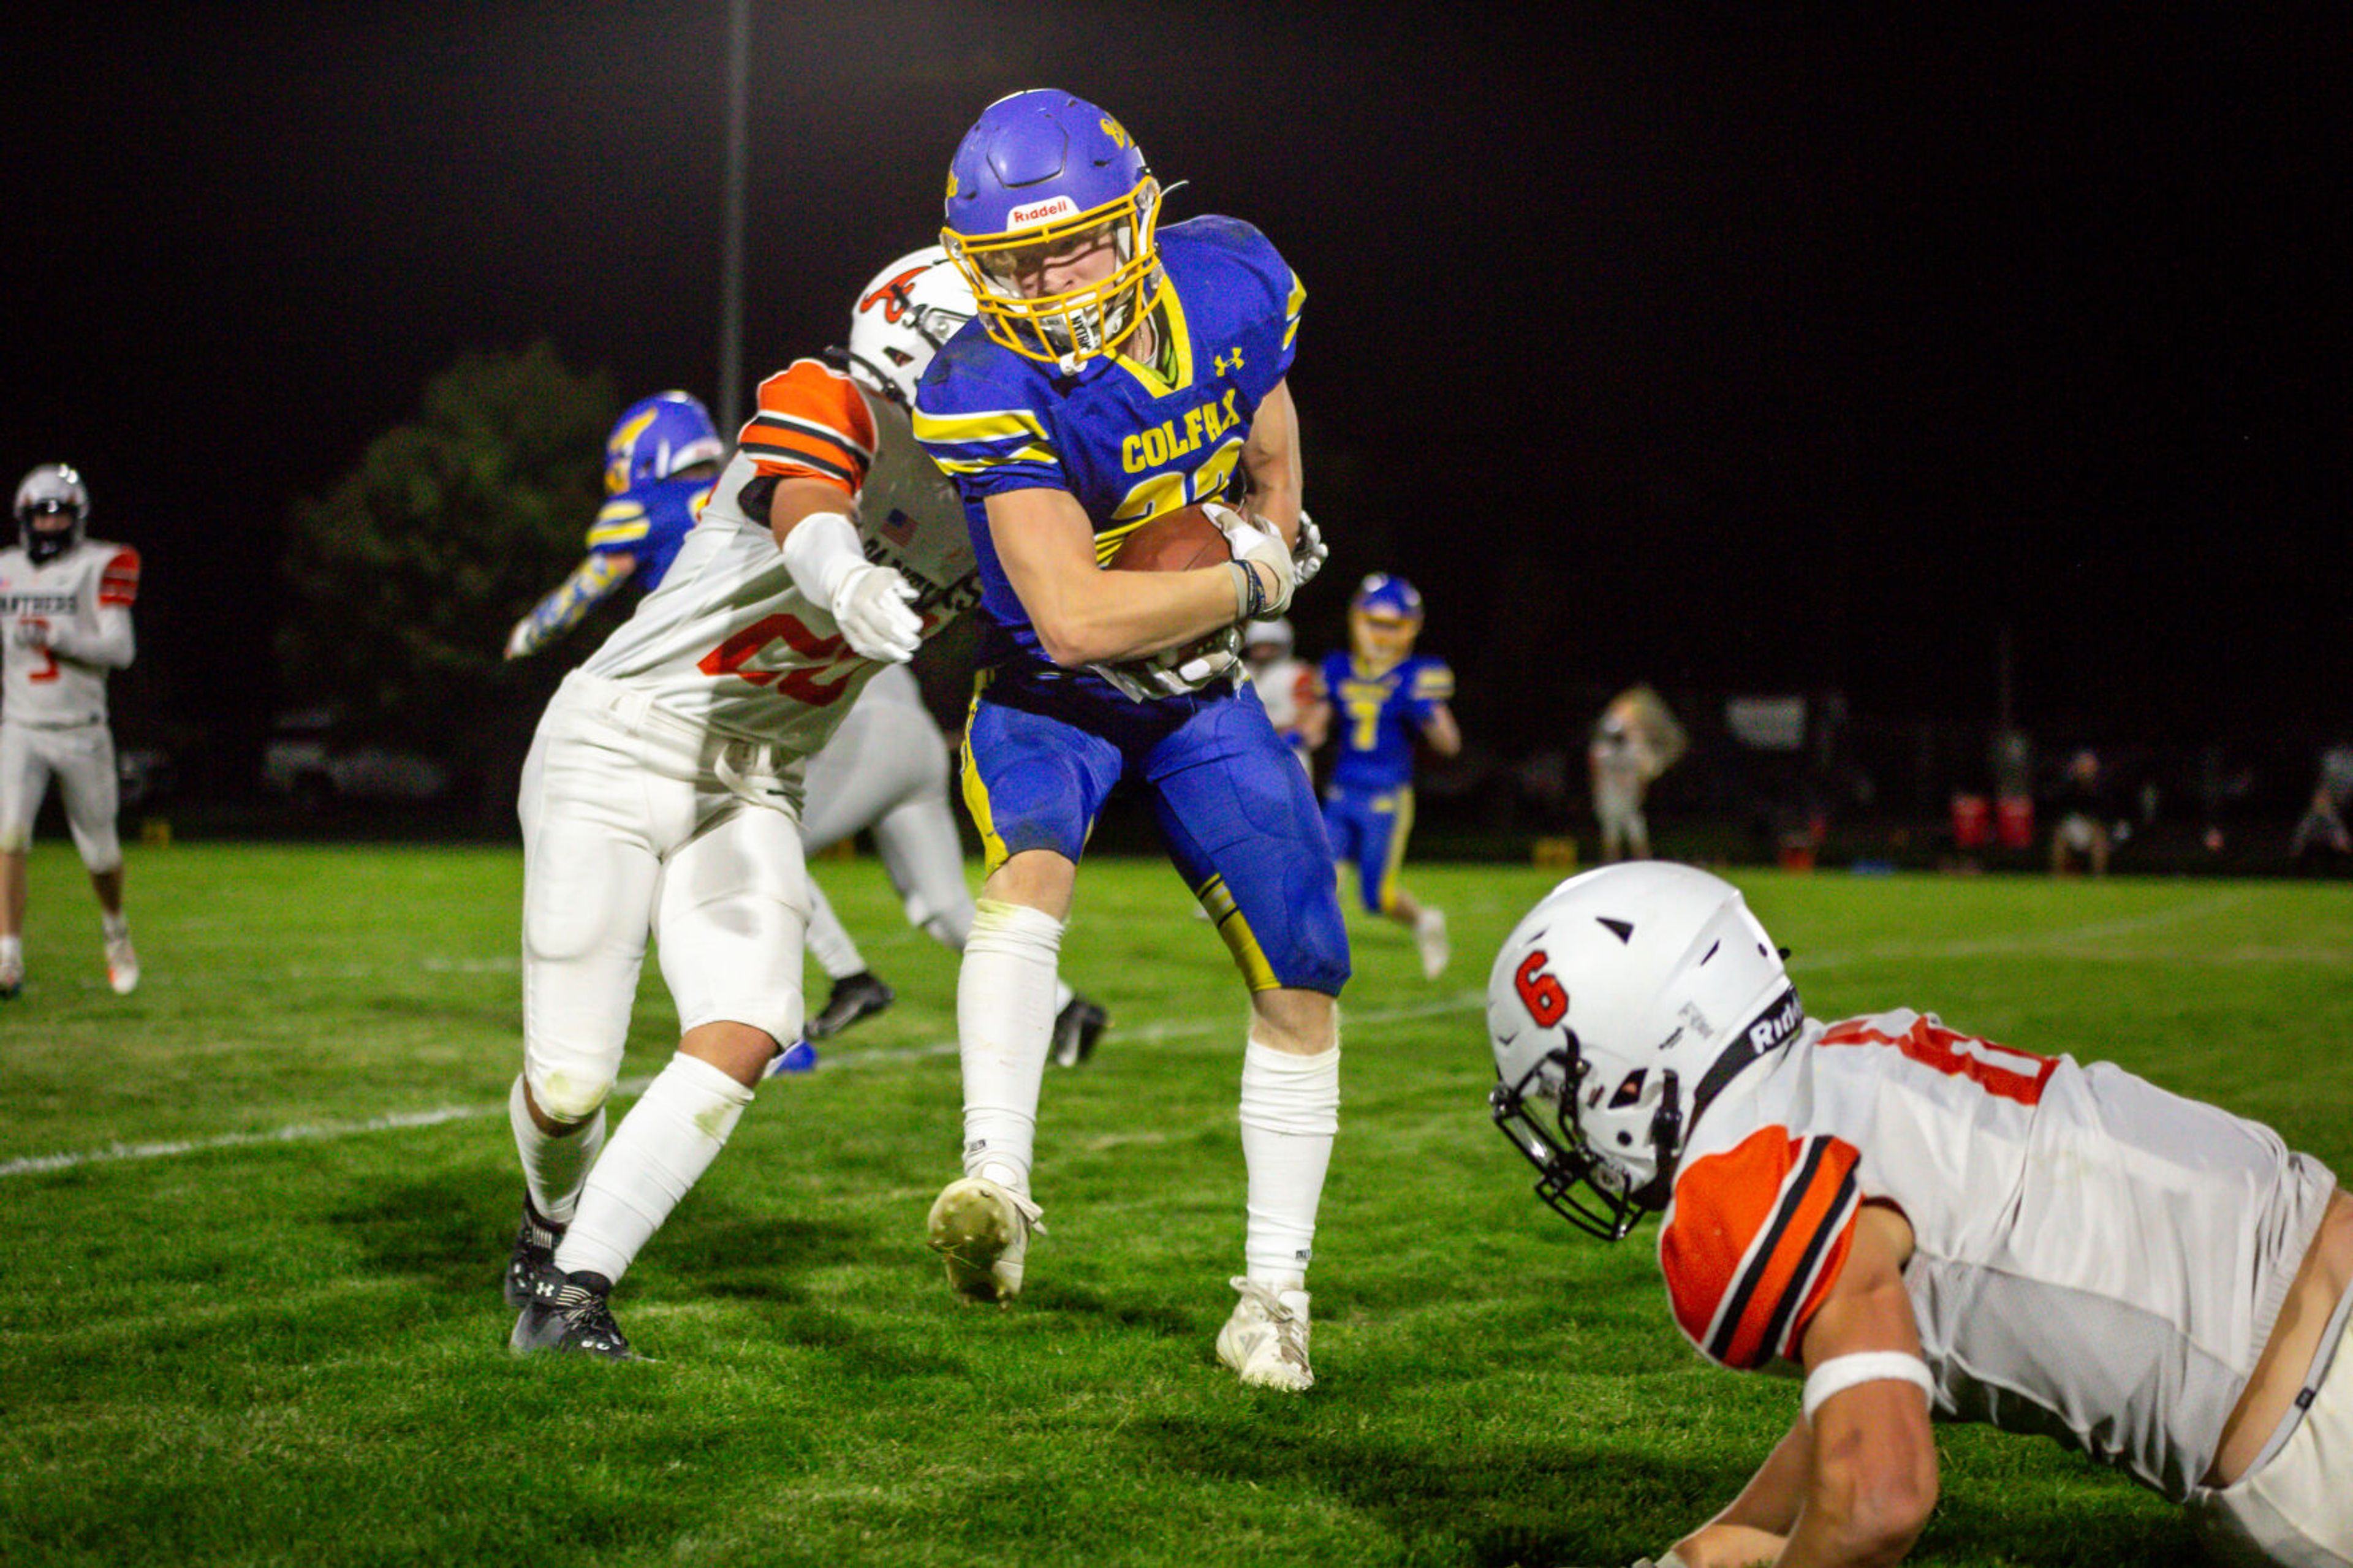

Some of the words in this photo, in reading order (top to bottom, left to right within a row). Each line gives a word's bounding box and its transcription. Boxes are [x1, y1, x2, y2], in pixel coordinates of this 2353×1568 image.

[1014, 199, 1067, 223] Riddell
[1122, 388, 1241, 474] COLFAX
[1515, 950, 1569, 1029] 6
